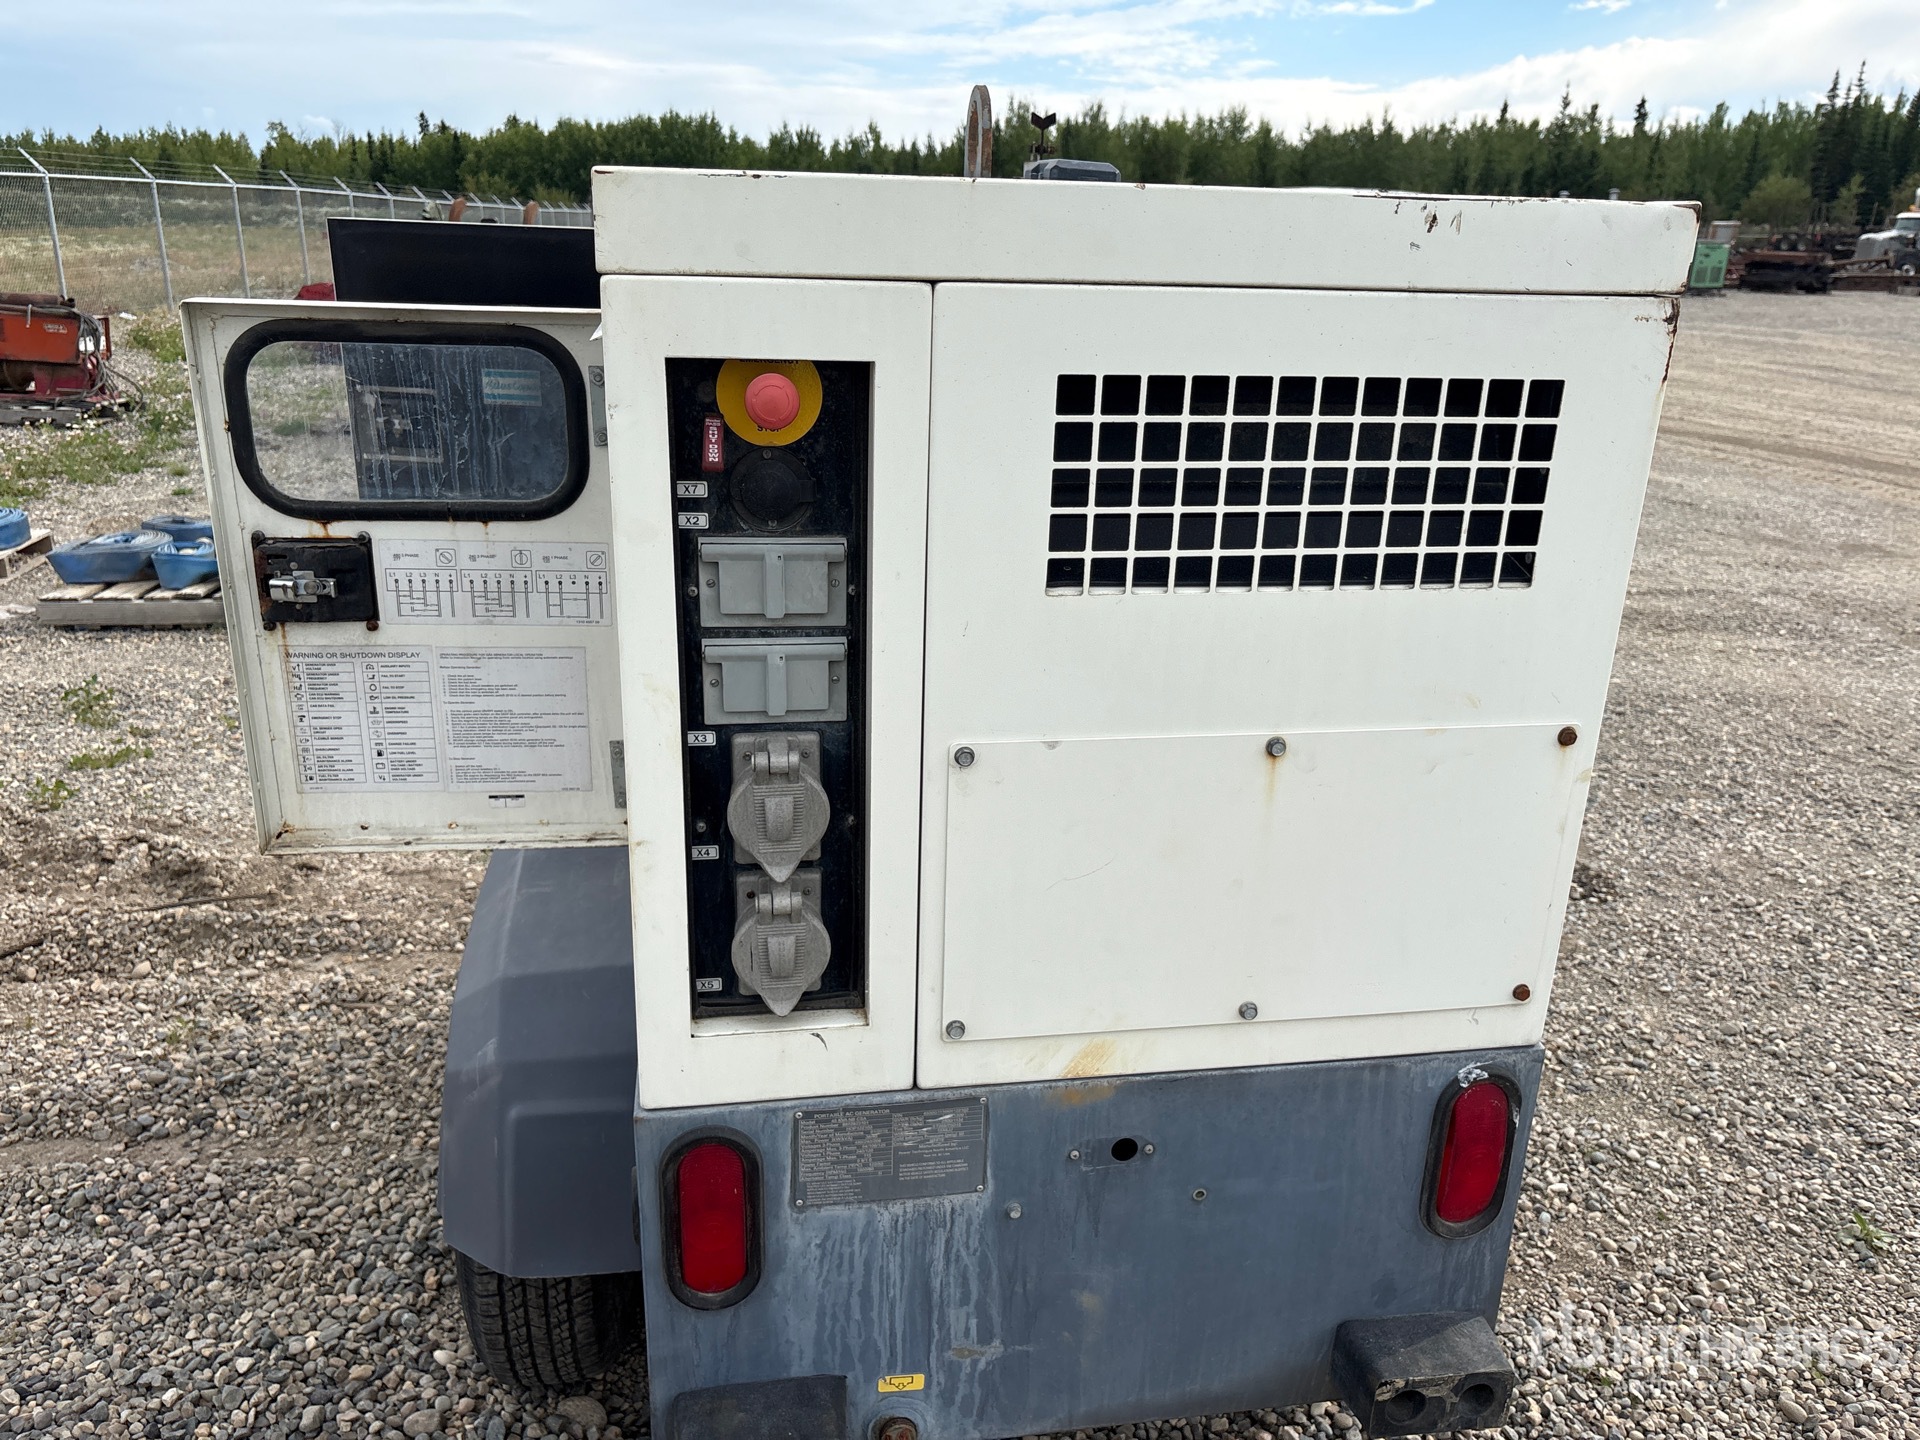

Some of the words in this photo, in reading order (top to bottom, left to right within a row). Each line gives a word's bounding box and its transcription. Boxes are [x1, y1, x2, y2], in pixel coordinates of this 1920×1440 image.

[709, 427, 718, 442] SHUT
[708, 444, 719, 462] DOWN
[684, 485, 698, 494] X7
[685, 516, 700, 525] X2
[693, 734, 707, 743] X3
[696, 848, 710, 857] X4
[701, 980, 714, 989] X5
